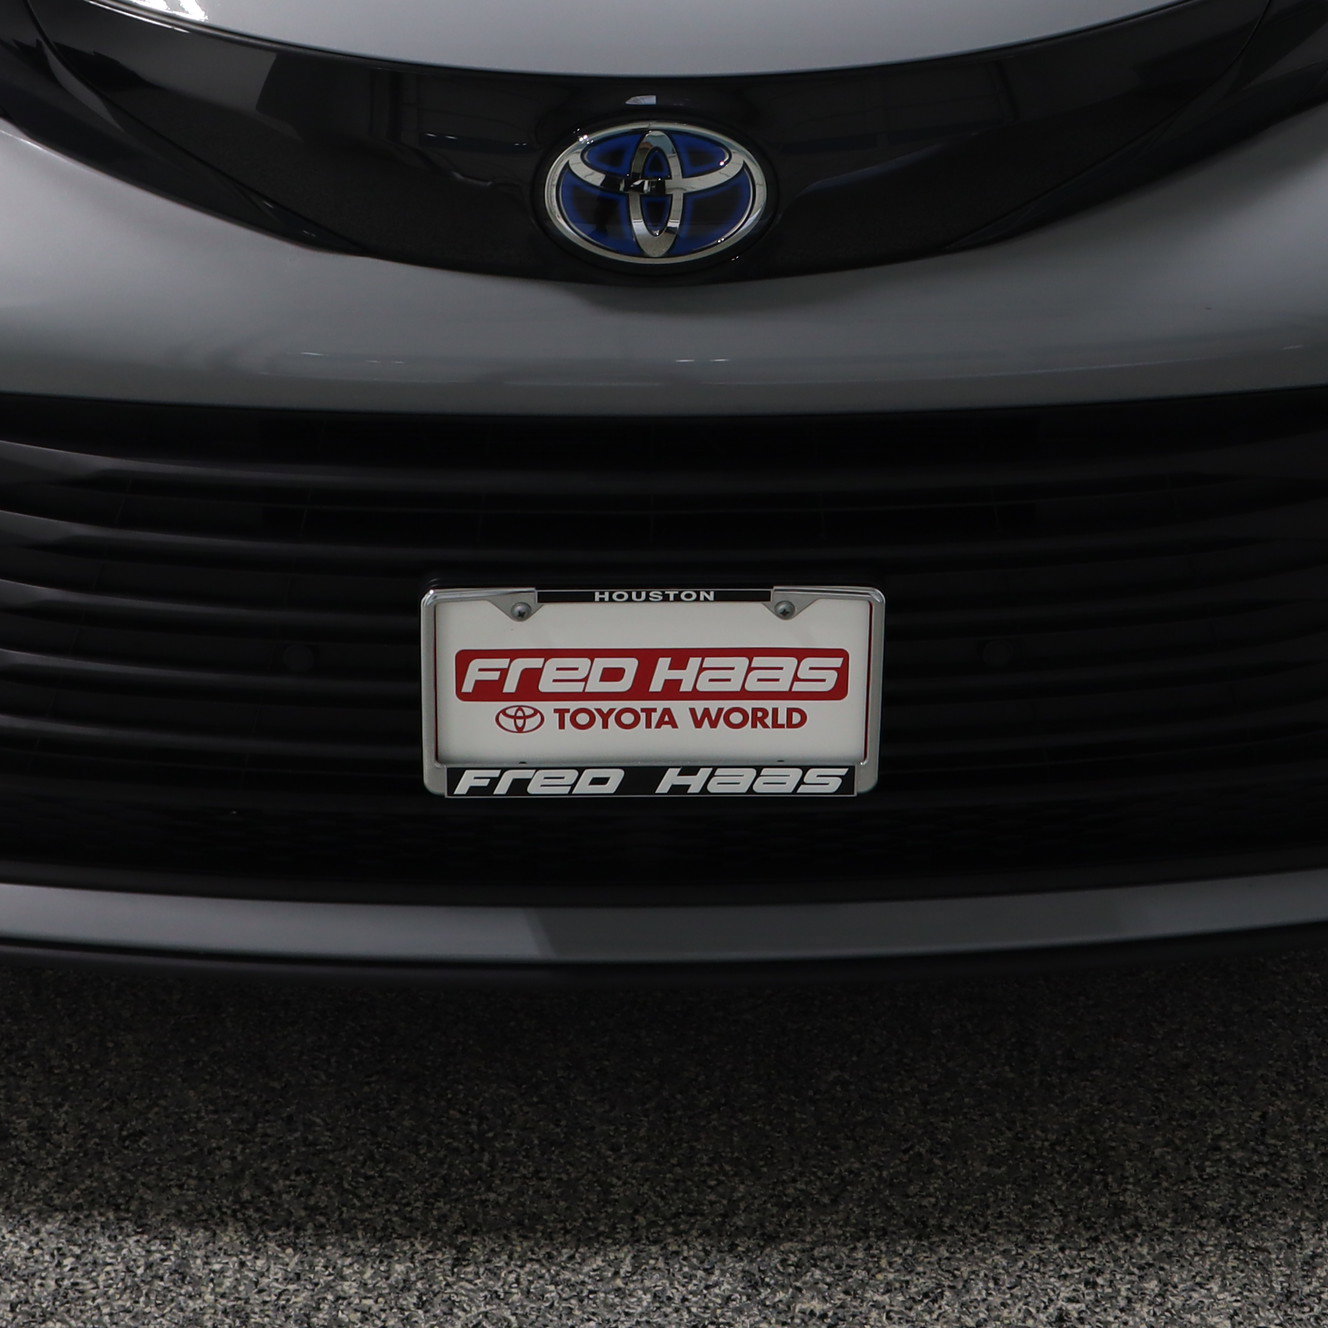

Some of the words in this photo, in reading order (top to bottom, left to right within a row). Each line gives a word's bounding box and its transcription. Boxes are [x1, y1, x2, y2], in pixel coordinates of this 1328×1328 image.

[593, 591, 715, 602] HOUSTON
[553, 707, 679, 730] TOYOTA
[688, 707, 808, 730] WORLD
